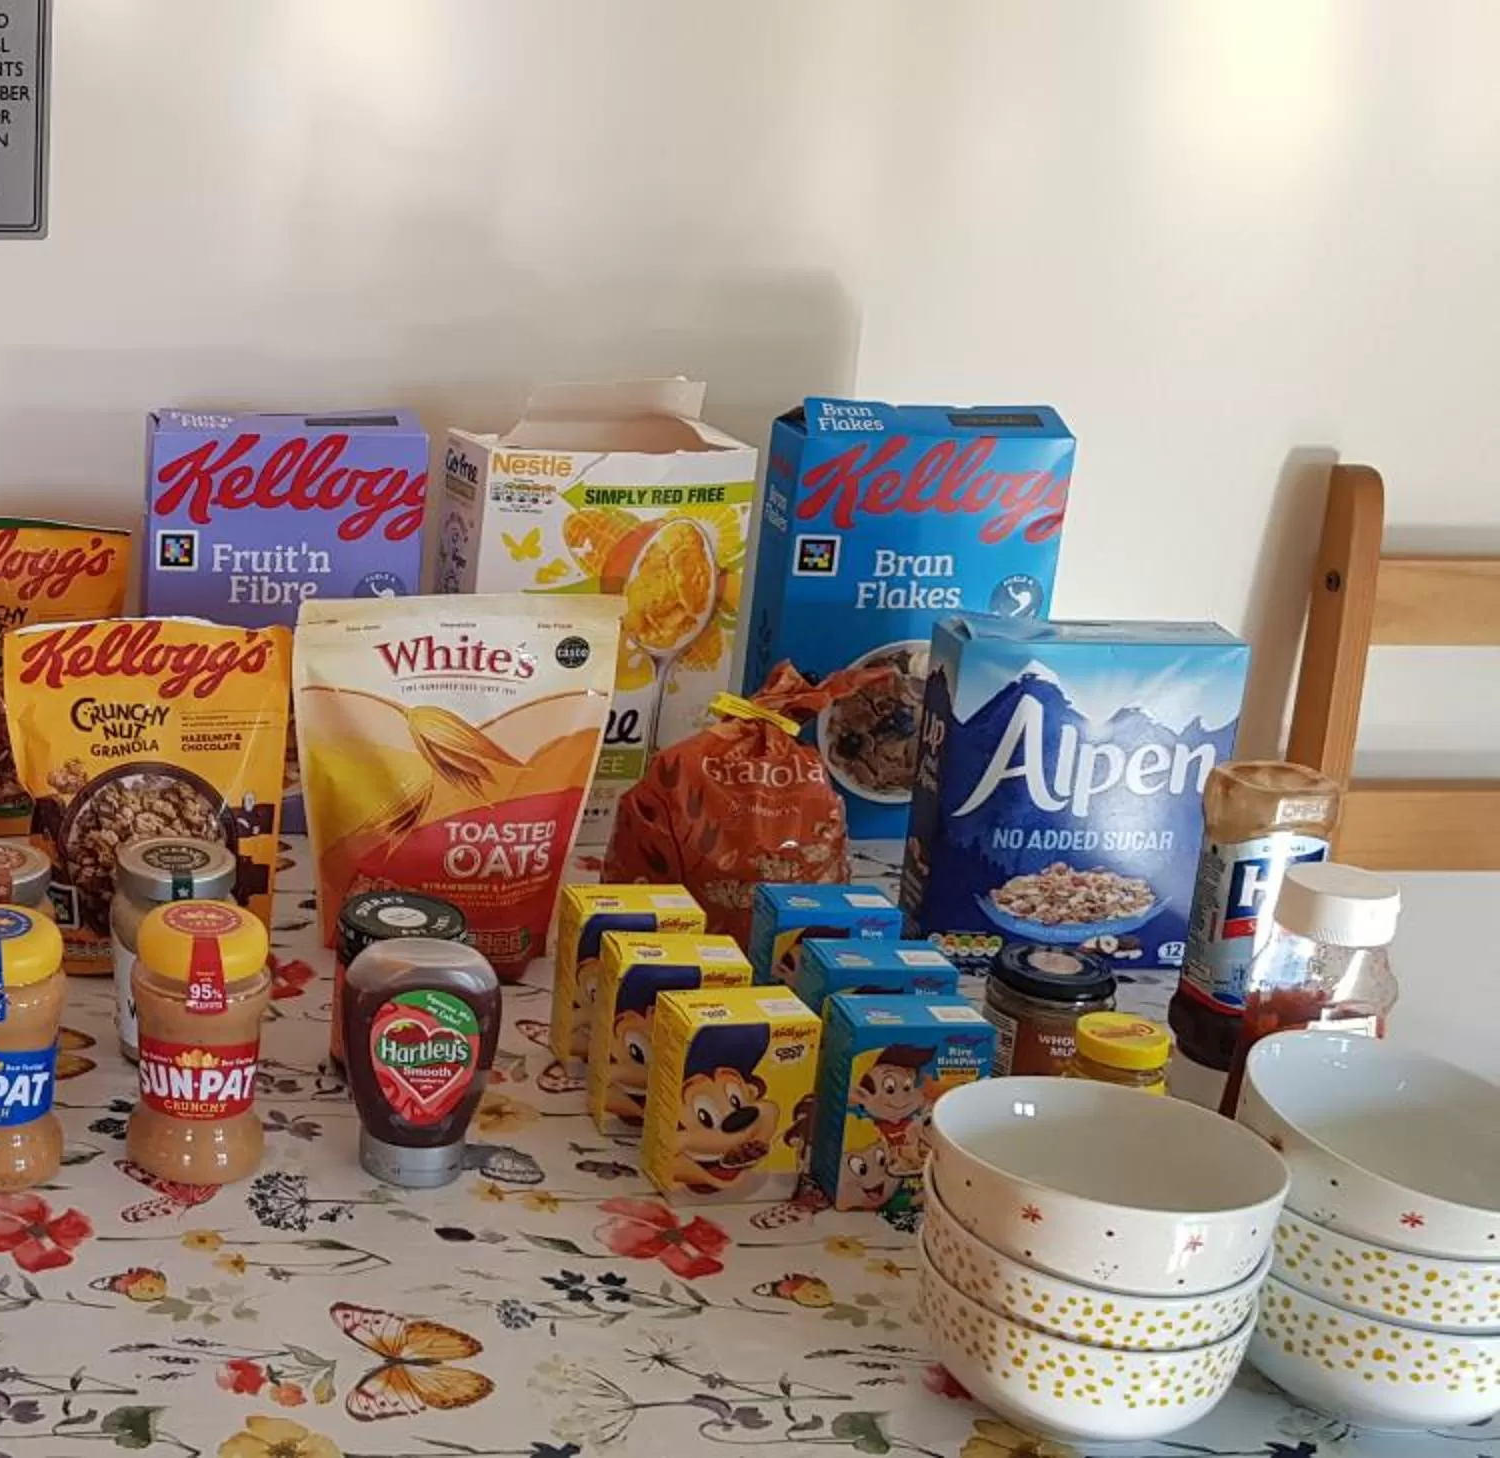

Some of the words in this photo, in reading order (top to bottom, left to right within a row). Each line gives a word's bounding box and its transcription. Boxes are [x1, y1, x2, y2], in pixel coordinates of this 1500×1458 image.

[822, 402, 872, 418] Bran
[817, 417, 885, 432] Flakes
[584, 489, 646, 505] SIMPLY
[651, 488, 682, 504] RED
[687, 487, 725, 502] FREE
[211, 542, 331, 574] Fruit'n
[873, 549, 954, 577] Bran
[228, 576, 318, 605] Fibre
[856, 582, 963, 609] Flakes
[19, 621, 273, 699] Kellogg's
[374, 634, 538, 681] White's
[70, 697, 170, 732] CRUNCHY
[103, 724, 146, 740] NUT
[181, 732, 232, 743] HAZELNUT
[235, 732, 243, 742] &
[90, 739, 160, 757] GRANOLA
[181, 742, 241, 753] CHOCOLATE
[951, 694, 1217, 818] Alpen
[443, 820, 556, 843] TOASTED
[992, 827, 1023, 849] NO
[1026, 829, 1099, 850] ADDED
[1102, 830, 1174, 850] SUGAR
[443, 841, 551, 879] OATS
[1164, 942, 1182, 957] 12
[190, 982, 222, 1001] 95%
[380, 1035, 469, 1067] Hartley's
[1038, 1035, 1077, 1046] WHOL
[402, 1064, 452, 1079] Smooth
[163, 1099, 228, 1114] CRUNCHY
